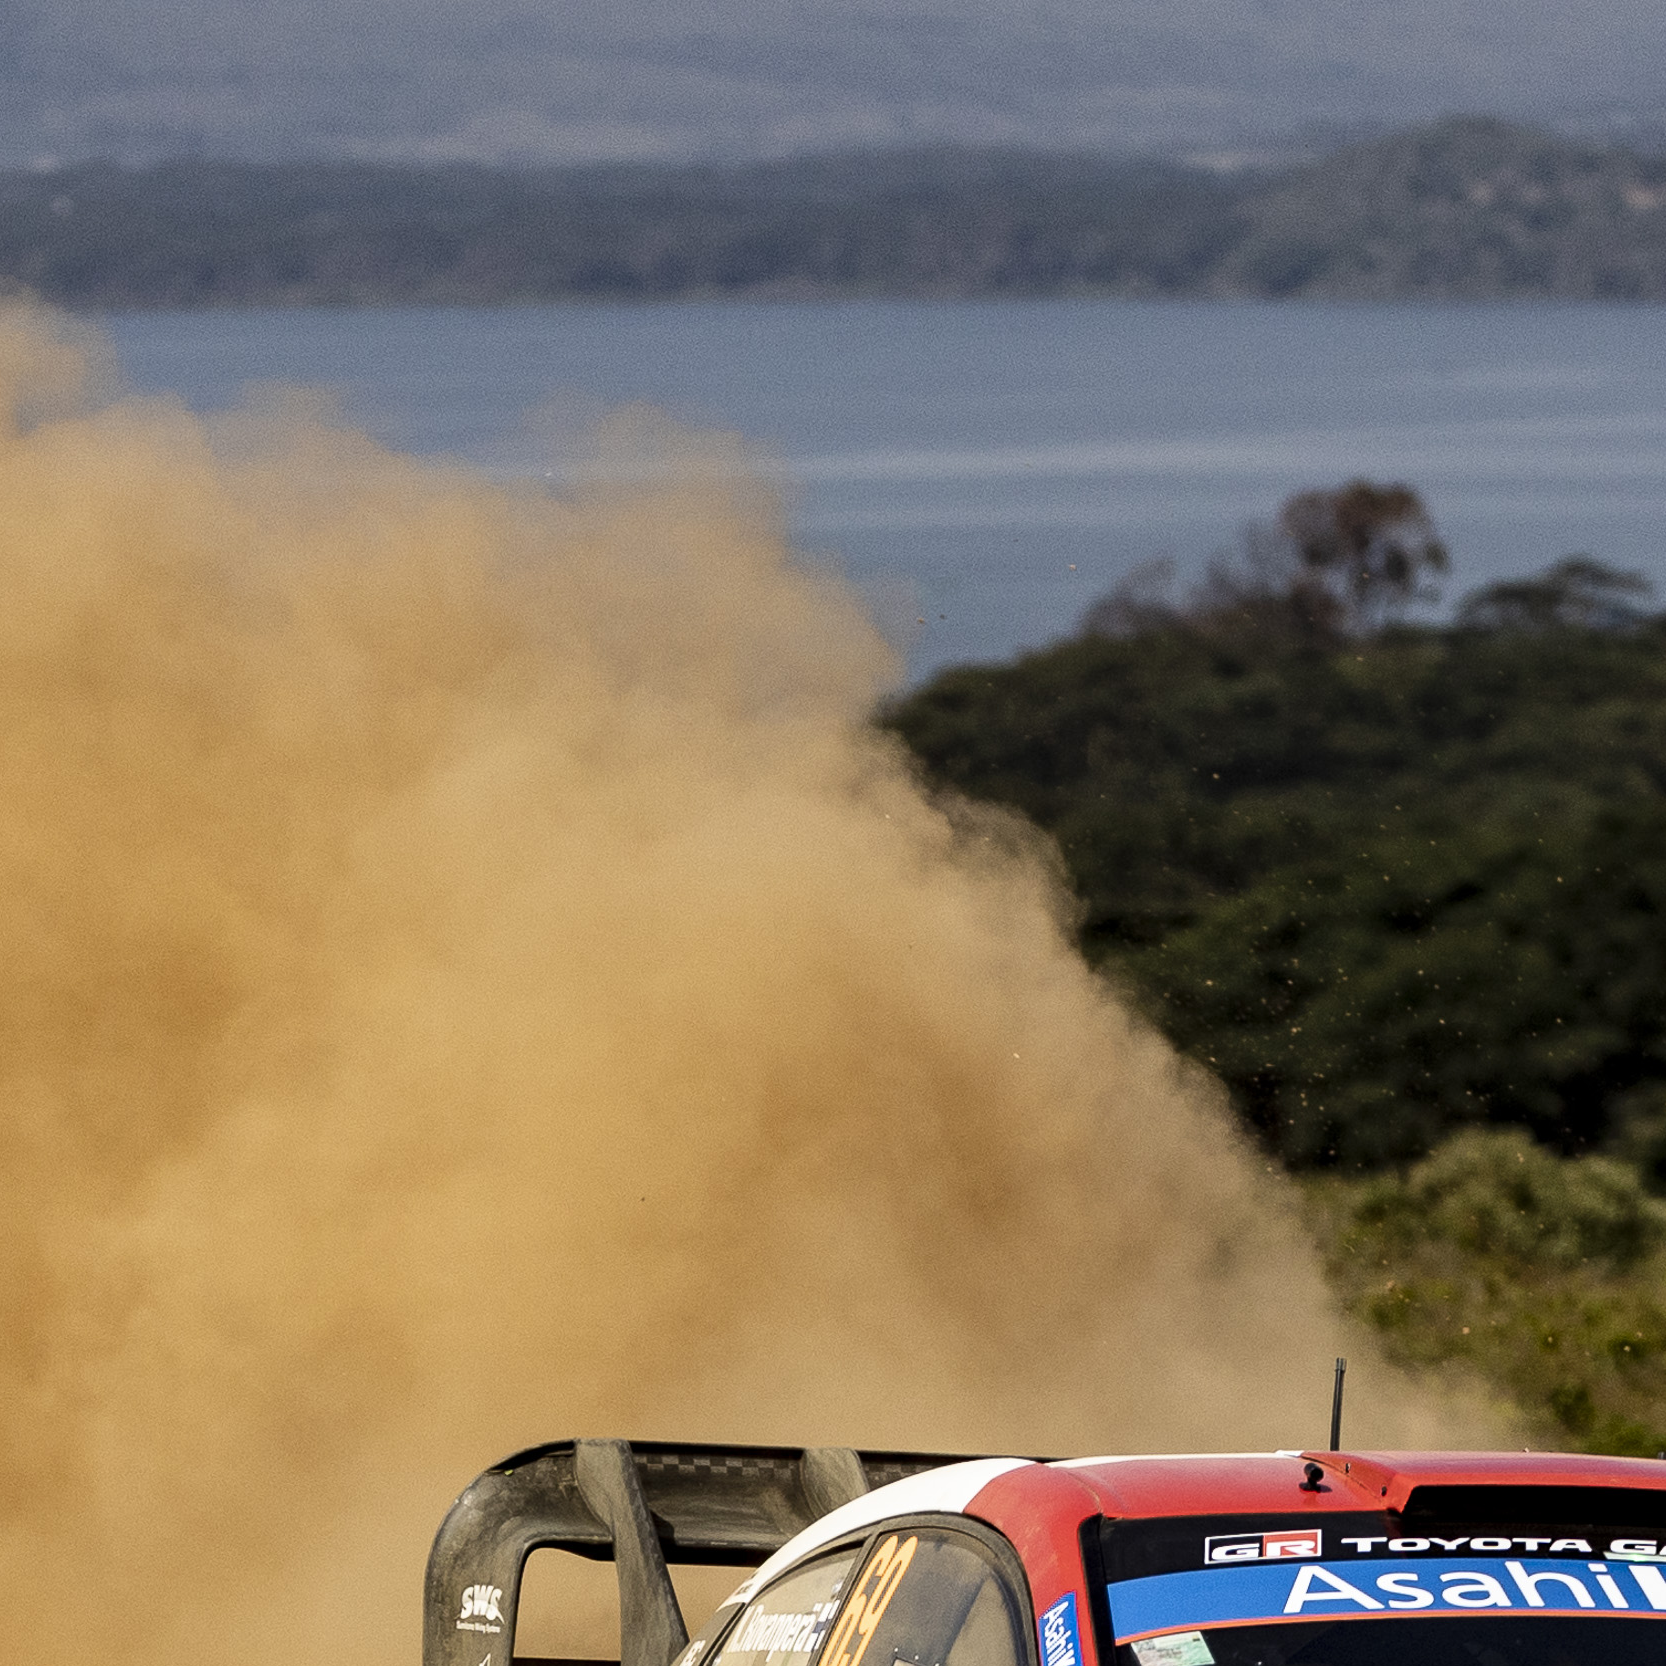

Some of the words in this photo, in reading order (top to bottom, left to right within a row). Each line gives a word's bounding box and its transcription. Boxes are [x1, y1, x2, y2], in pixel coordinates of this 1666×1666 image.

[1211, 1540, 1317, 1560] GR
[1340, 1536, 1593, 1553] TOYOTA
[459, 1584, 505, 1624] SWS
